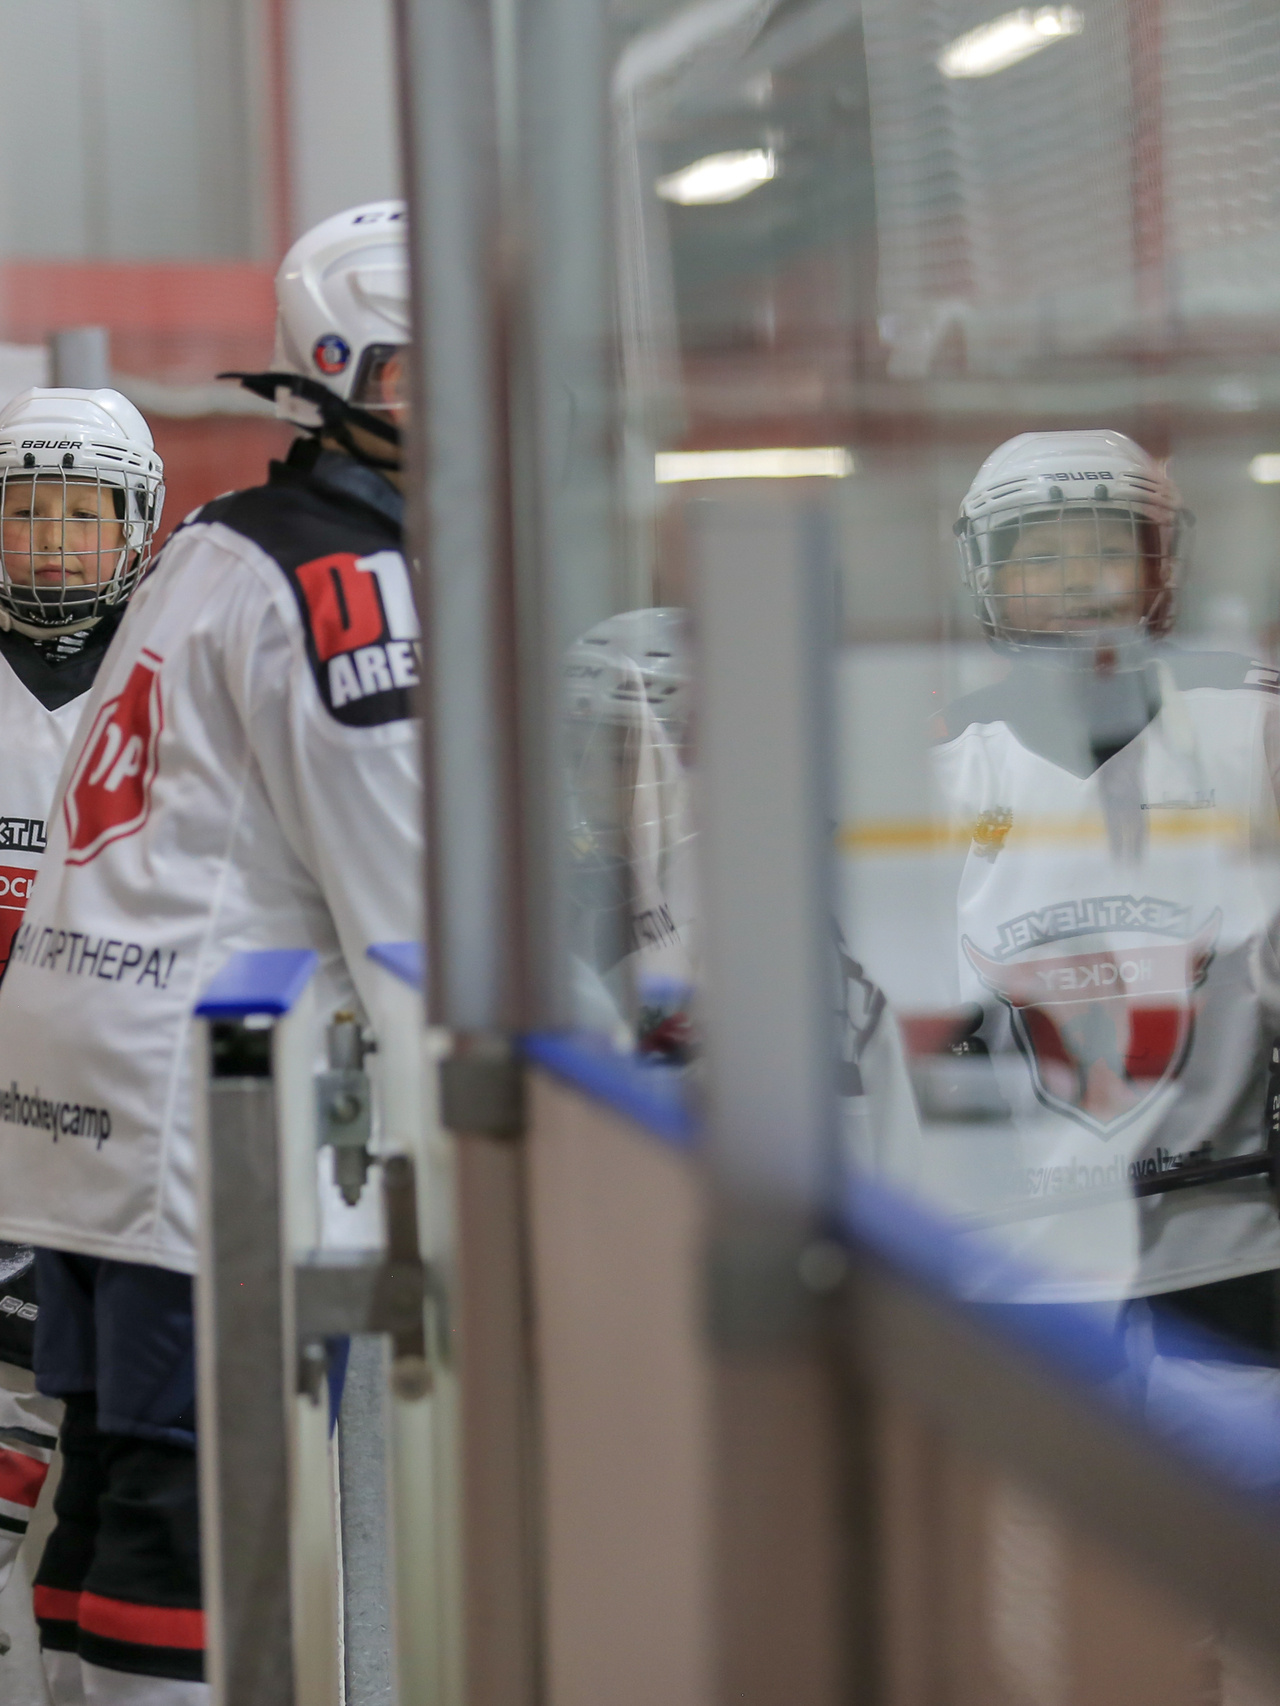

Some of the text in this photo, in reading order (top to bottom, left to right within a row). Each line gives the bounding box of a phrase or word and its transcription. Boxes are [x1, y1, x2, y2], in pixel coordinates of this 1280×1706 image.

[21, 440, 83, 450] BAUER
[295, 550, 421, 663] D1
[327, 641, 422, 709] ARE
